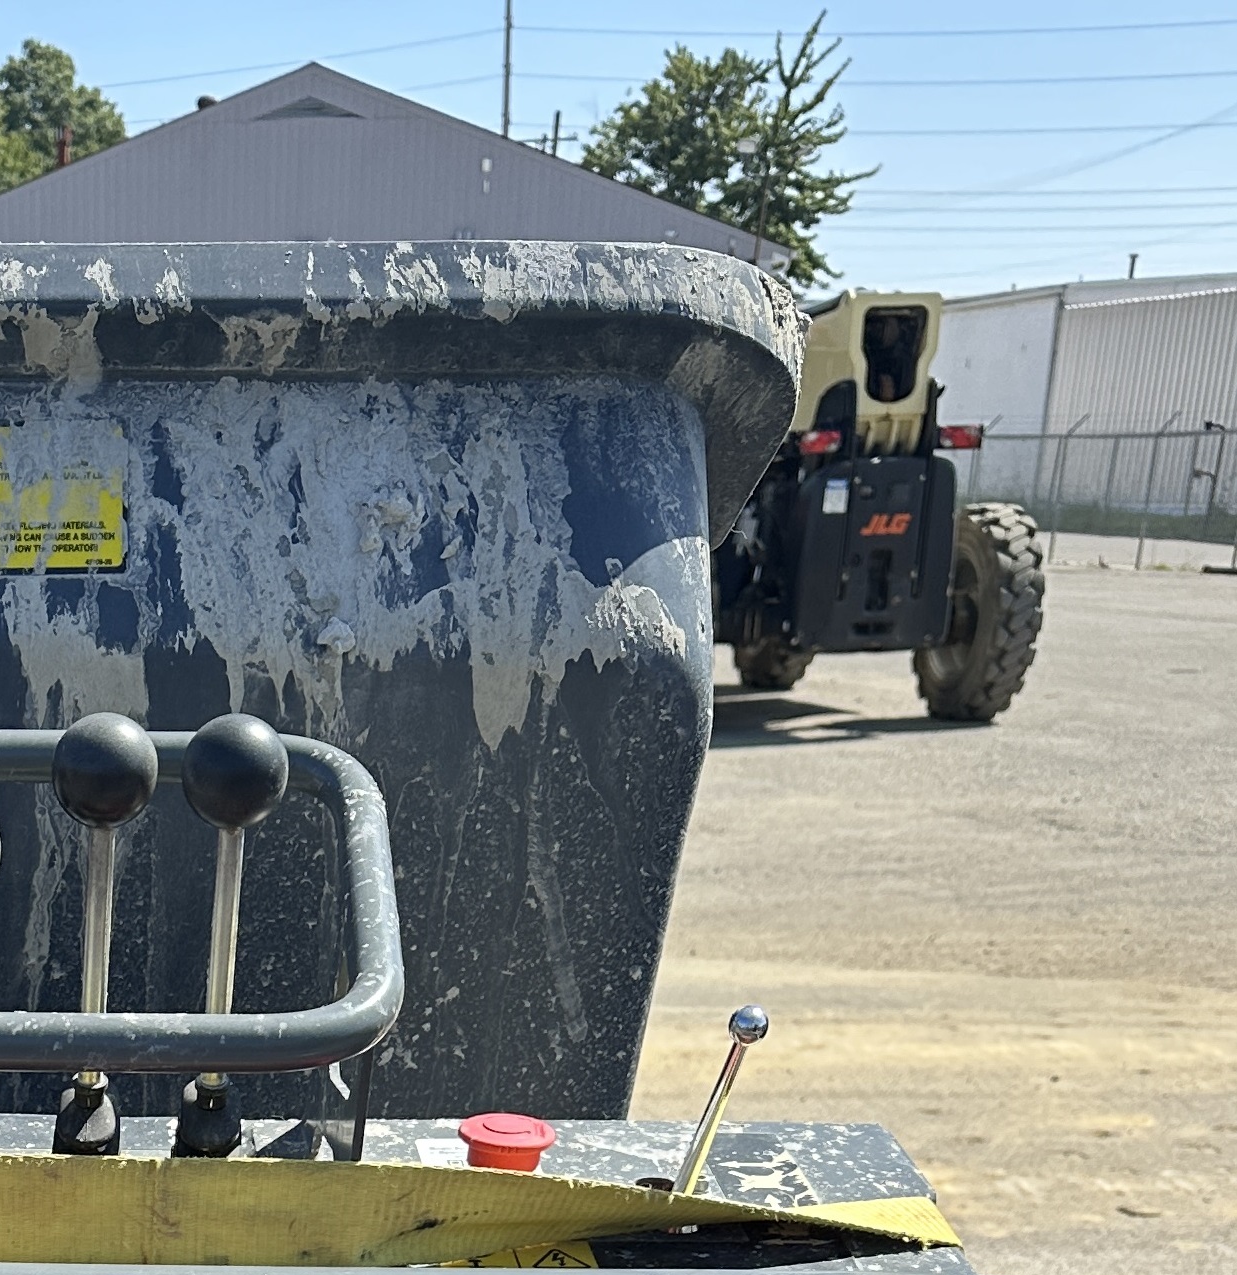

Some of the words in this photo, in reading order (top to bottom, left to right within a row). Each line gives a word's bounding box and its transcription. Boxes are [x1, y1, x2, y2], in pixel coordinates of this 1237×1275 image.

[860, 512, 912, 536] JLG
[23, 533, 41, 541] CAN
[73, 532, 79, 540] A
